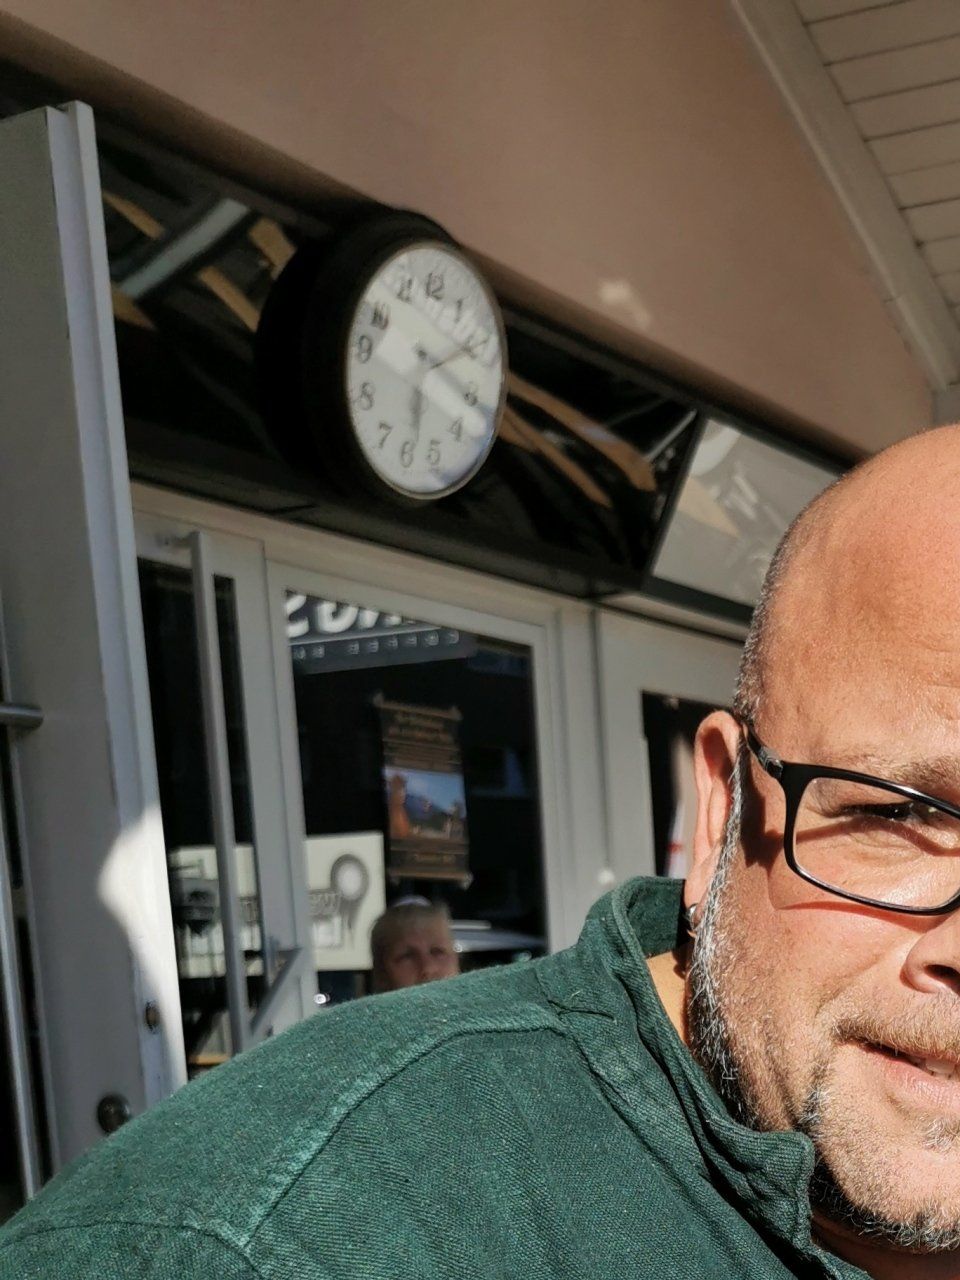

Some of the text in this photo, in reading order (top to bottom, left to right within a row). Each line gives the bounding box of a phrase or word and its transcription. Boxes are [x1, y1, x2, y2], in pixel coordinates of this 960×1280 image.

[357, 334, 373, 364] 9
[359, 381, 375, 412] 8
[378, 420, 392, 449] 7
[449, 416, 464, 442] 4
[401, 440, 415, 468] 6
[427, 439, 441, 465] 5
